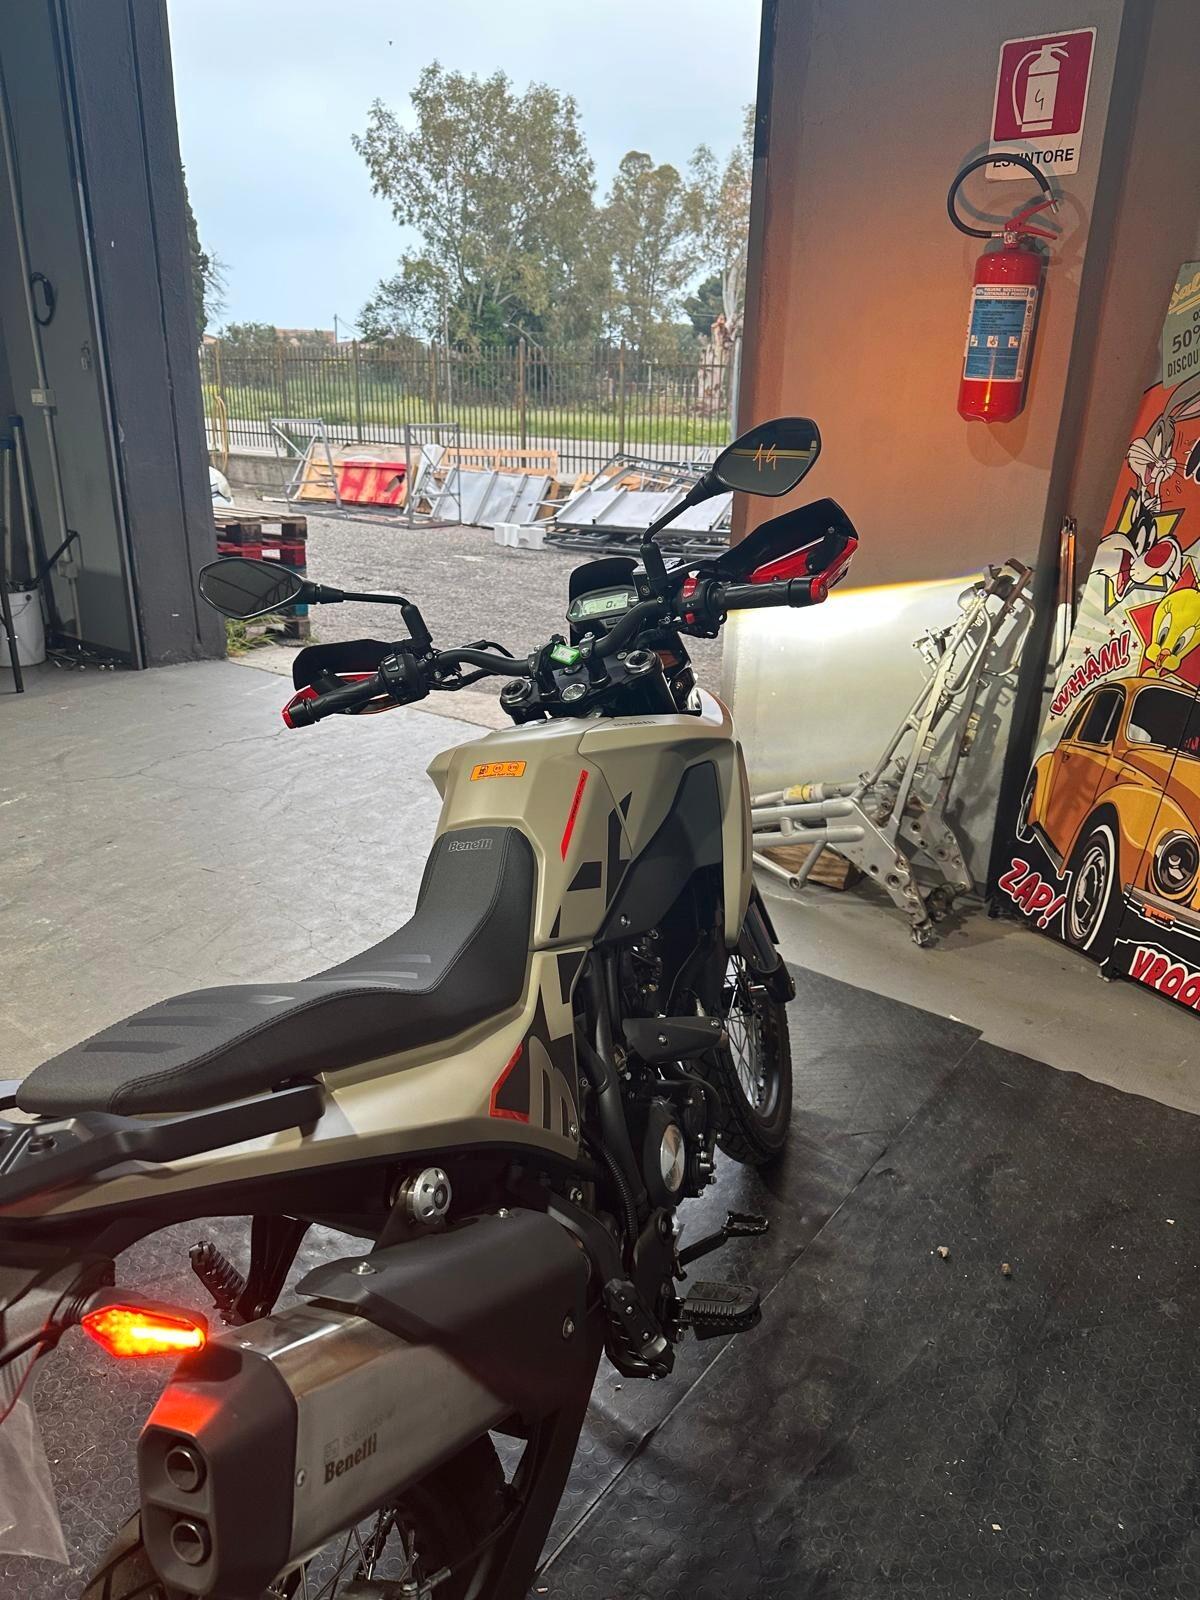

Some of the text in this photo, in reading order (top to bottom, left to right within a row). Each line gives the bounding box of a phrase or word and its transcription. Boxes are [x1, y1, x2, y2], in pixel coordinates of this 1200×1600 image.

[1034, 88, 1045, 111] 4
[1051, 631, 1130, 714] WHAM!
[449, 838, 493, 852] Benelli
[999, 858, 1067, 928] ZAP!
[1130, 947, 1200, 1012] VROO
[324, 1432, 377, 1485] Benelli
